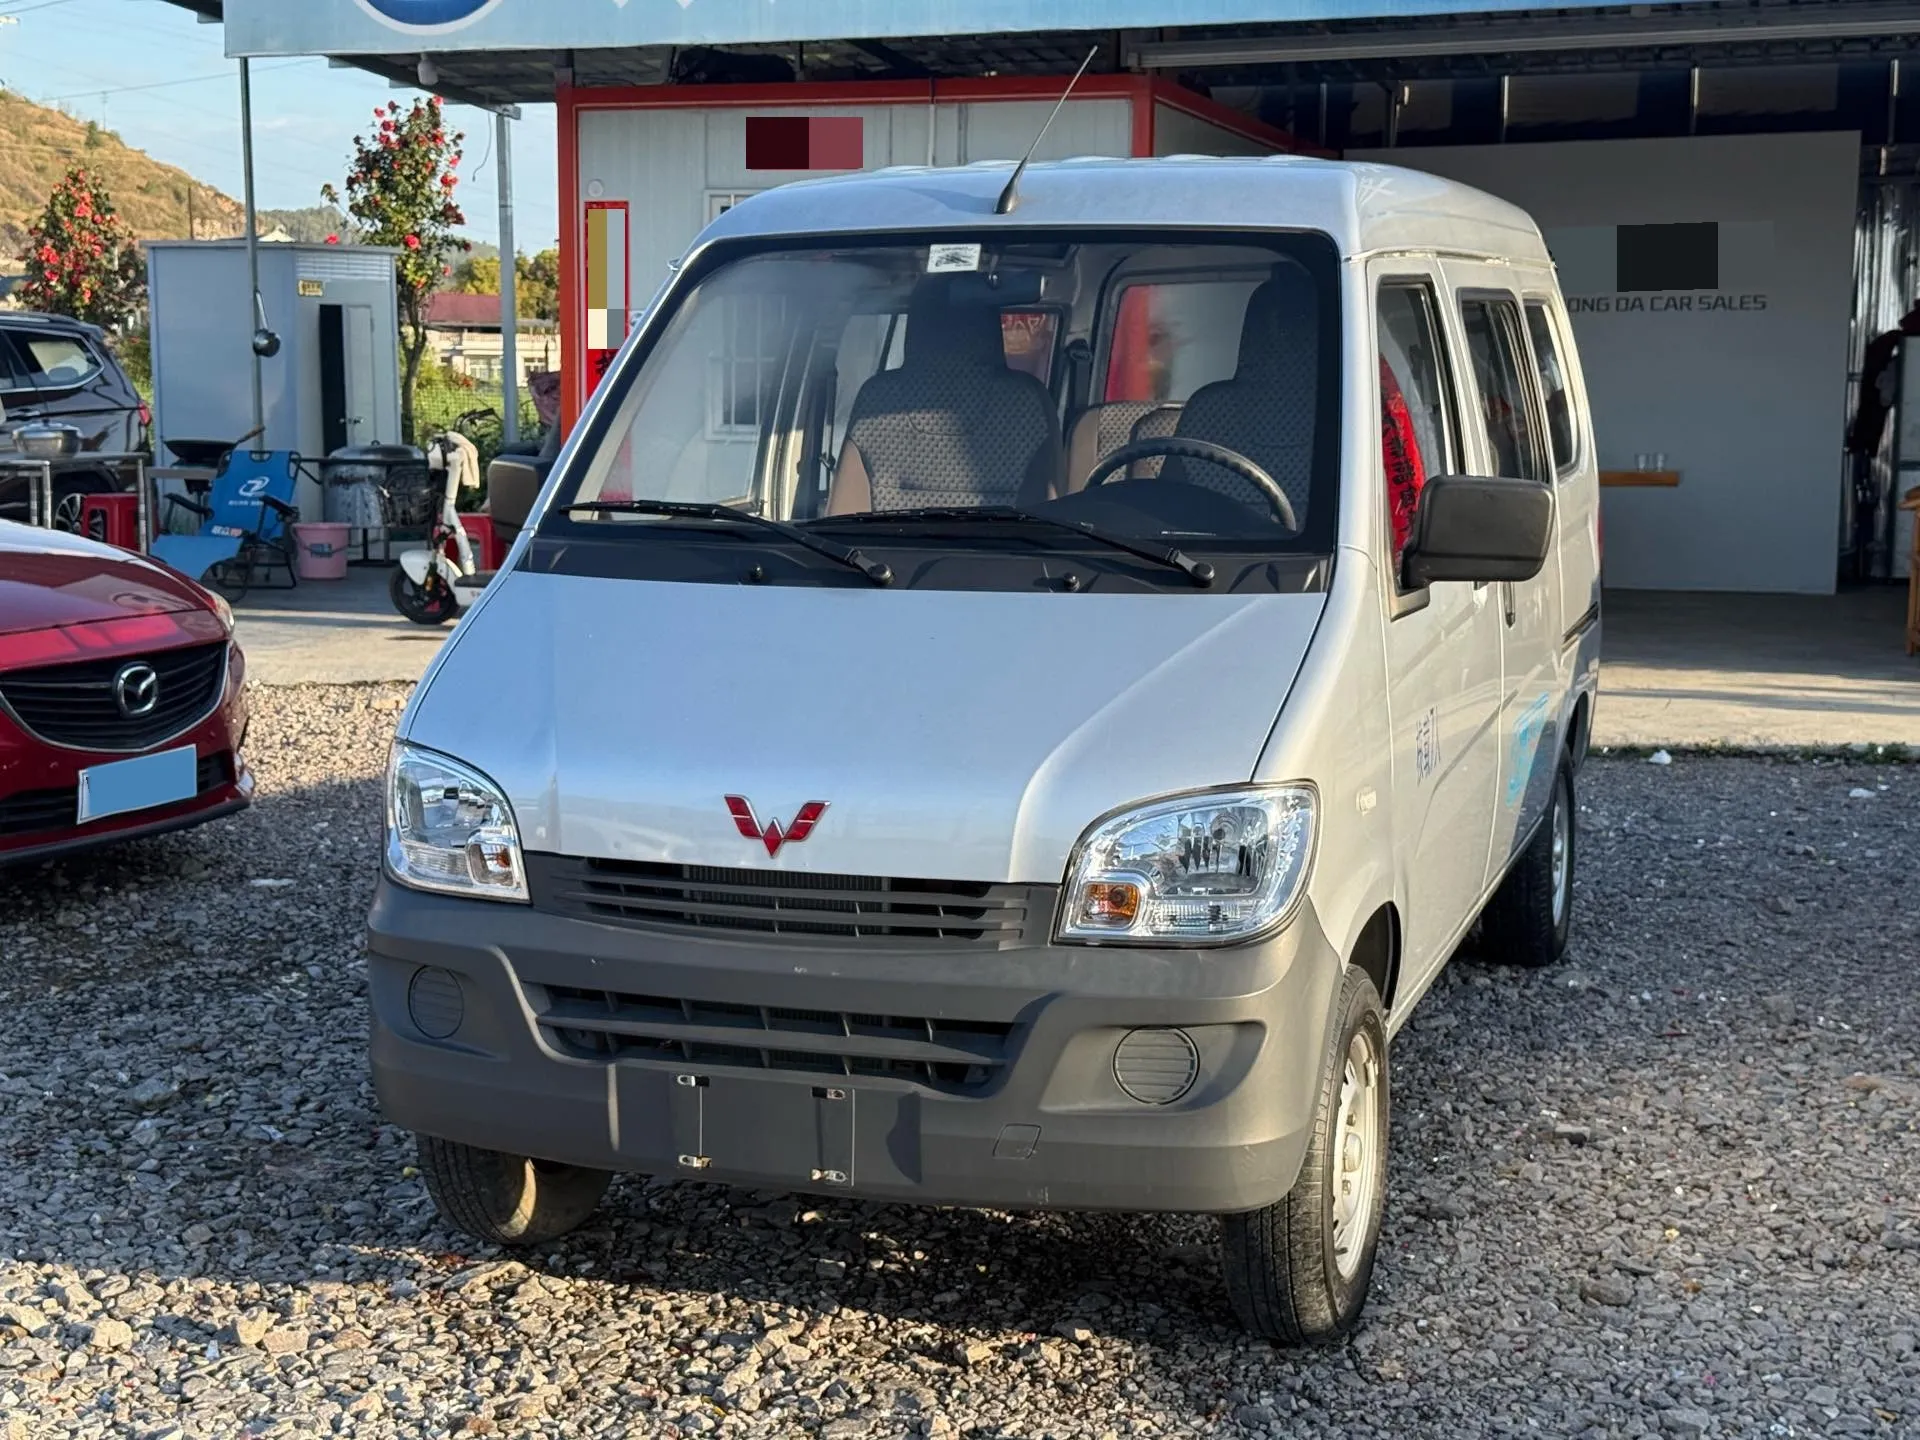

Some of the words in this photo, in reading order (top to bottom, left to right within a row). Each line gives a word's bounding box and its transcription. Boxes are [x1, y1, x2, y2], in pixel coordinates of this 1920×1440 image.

[1616, 296, 1645, 312] DA
[1650, 295, 1692, 312] CAR
[1698, 294, 1767, 311] SALES
